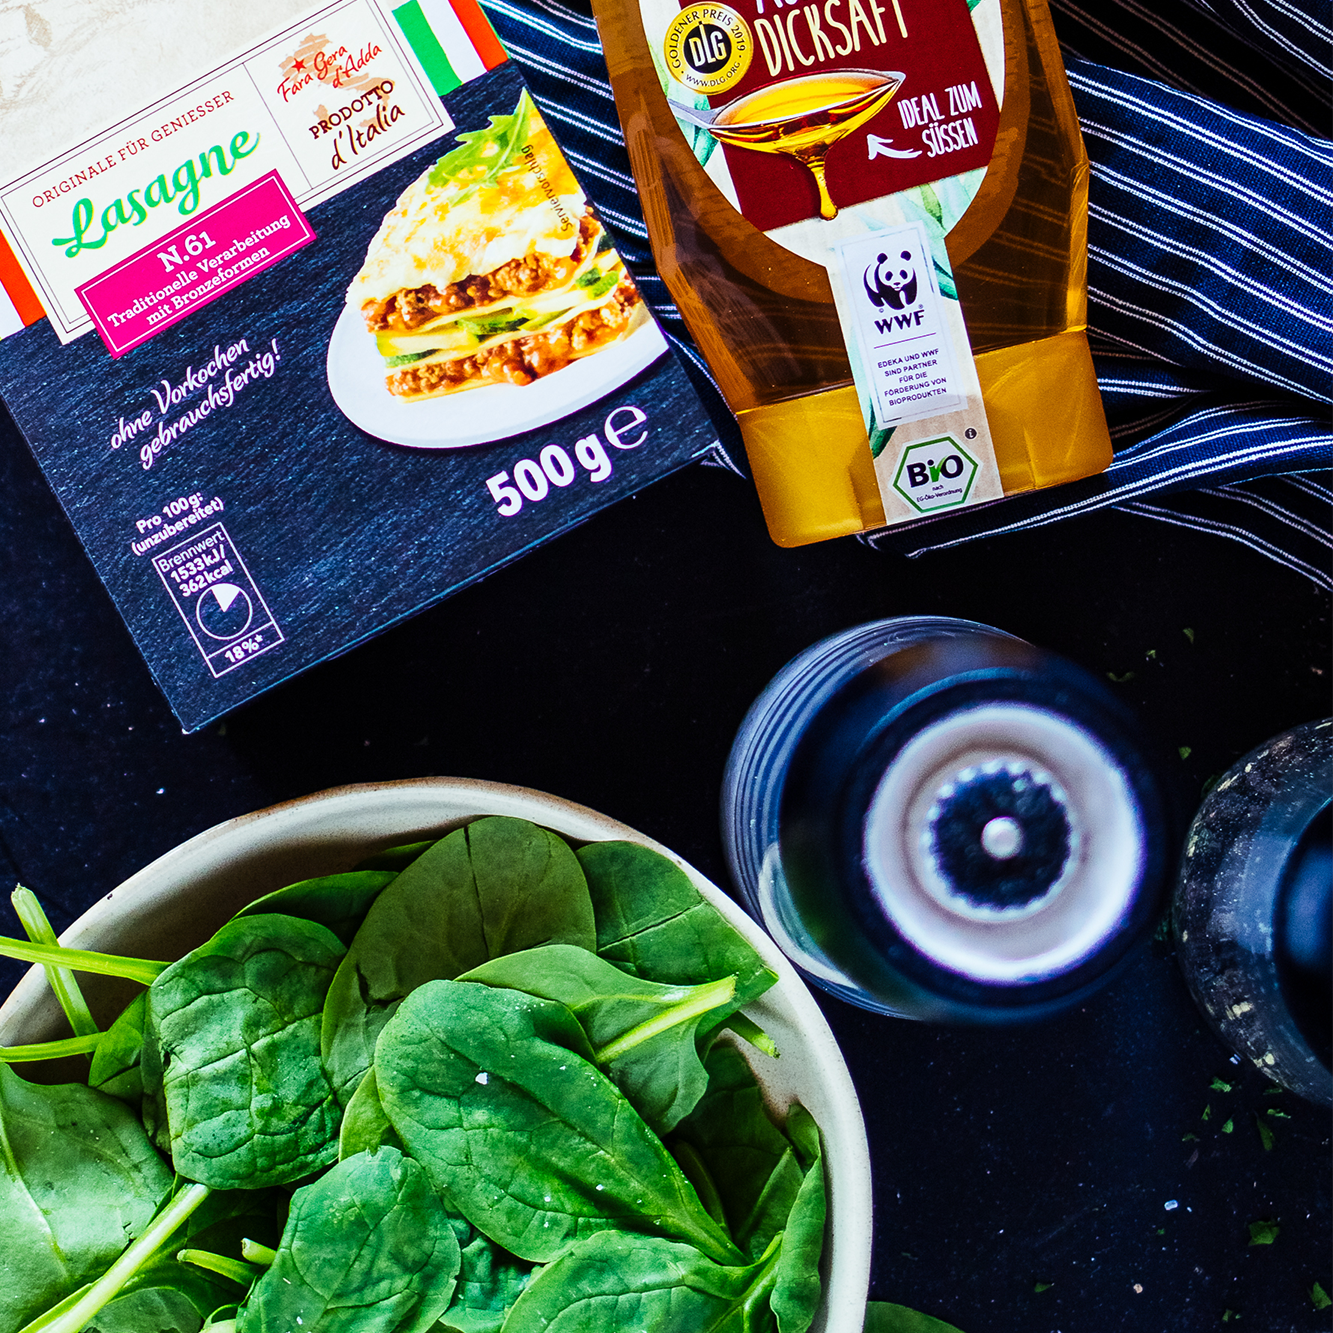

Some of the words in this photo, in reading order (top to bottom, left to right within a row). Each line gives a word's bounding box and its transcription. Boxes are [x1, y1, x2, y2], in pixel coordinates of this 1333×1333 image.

[669, 10, 700, 69] GOLDENER
[702, 8, 734, 26] PREIS
[731, 24, 746, 52] 2019
[688, 21, 727, 67] DLG
[276, 73, 314, 102] Fara
[313, 45, 348, 80] Gera
[332, 42, 382, 88] d'Adda
[686, 61, 741, 87] WWW.DLG.ORG
[309, 80, 394, 139] PRODOTTO
[897, 92, 945, 129] IDEAL
[944, 80, 982, 116] ZUM
[32, 155, 117, 208] ORIGINALE
[117, 137, 150, 161] FÜR
[150, 90, 234, 142] GENIESSER
[331, 103, 405, 170] d'Italia
[921, 117, 979, 158] SÜSSEN
[51, 130, 261, 259] Lasagne
[520, 143, 574, 233] Serviervorschlag
[107, 271, 198, 328] Traditionelle
[196, 215, 291, 273] Verarbeitung
[156, 230, 217, 273] N.61
[145, 304, 172, 326] mit
[170, 247, 270, 310] Bronzeformen
[874, 308, 925, 335] WWF
[877, 357, 904, 369] EDEKA
[904, 353, 920, 362] UND
[921, 348, 939, 358] WWF
[884, 367, 902, 377] SIND
[903, 359, 938, 372] PARTNER
[899, 374, 914, 384] FÜR
[915, 371, 928, 380] DIE
[110, 410, 153, 449] ohne
[150, 339, 251, 414] Vorkochen
[139, 338, 281, 470] gebrauchsfertig!
[884, 381, 930, 397] FÖRDERUNG
[930, 377, 947, 386] VON
[889, 387, 947, 406] BIOPRODUKTEN
[131, 496, 225, 557] (unzubereitet)
[135, 514, 162, 534] Pro
[157, 530, 226, 573] Brennwert
